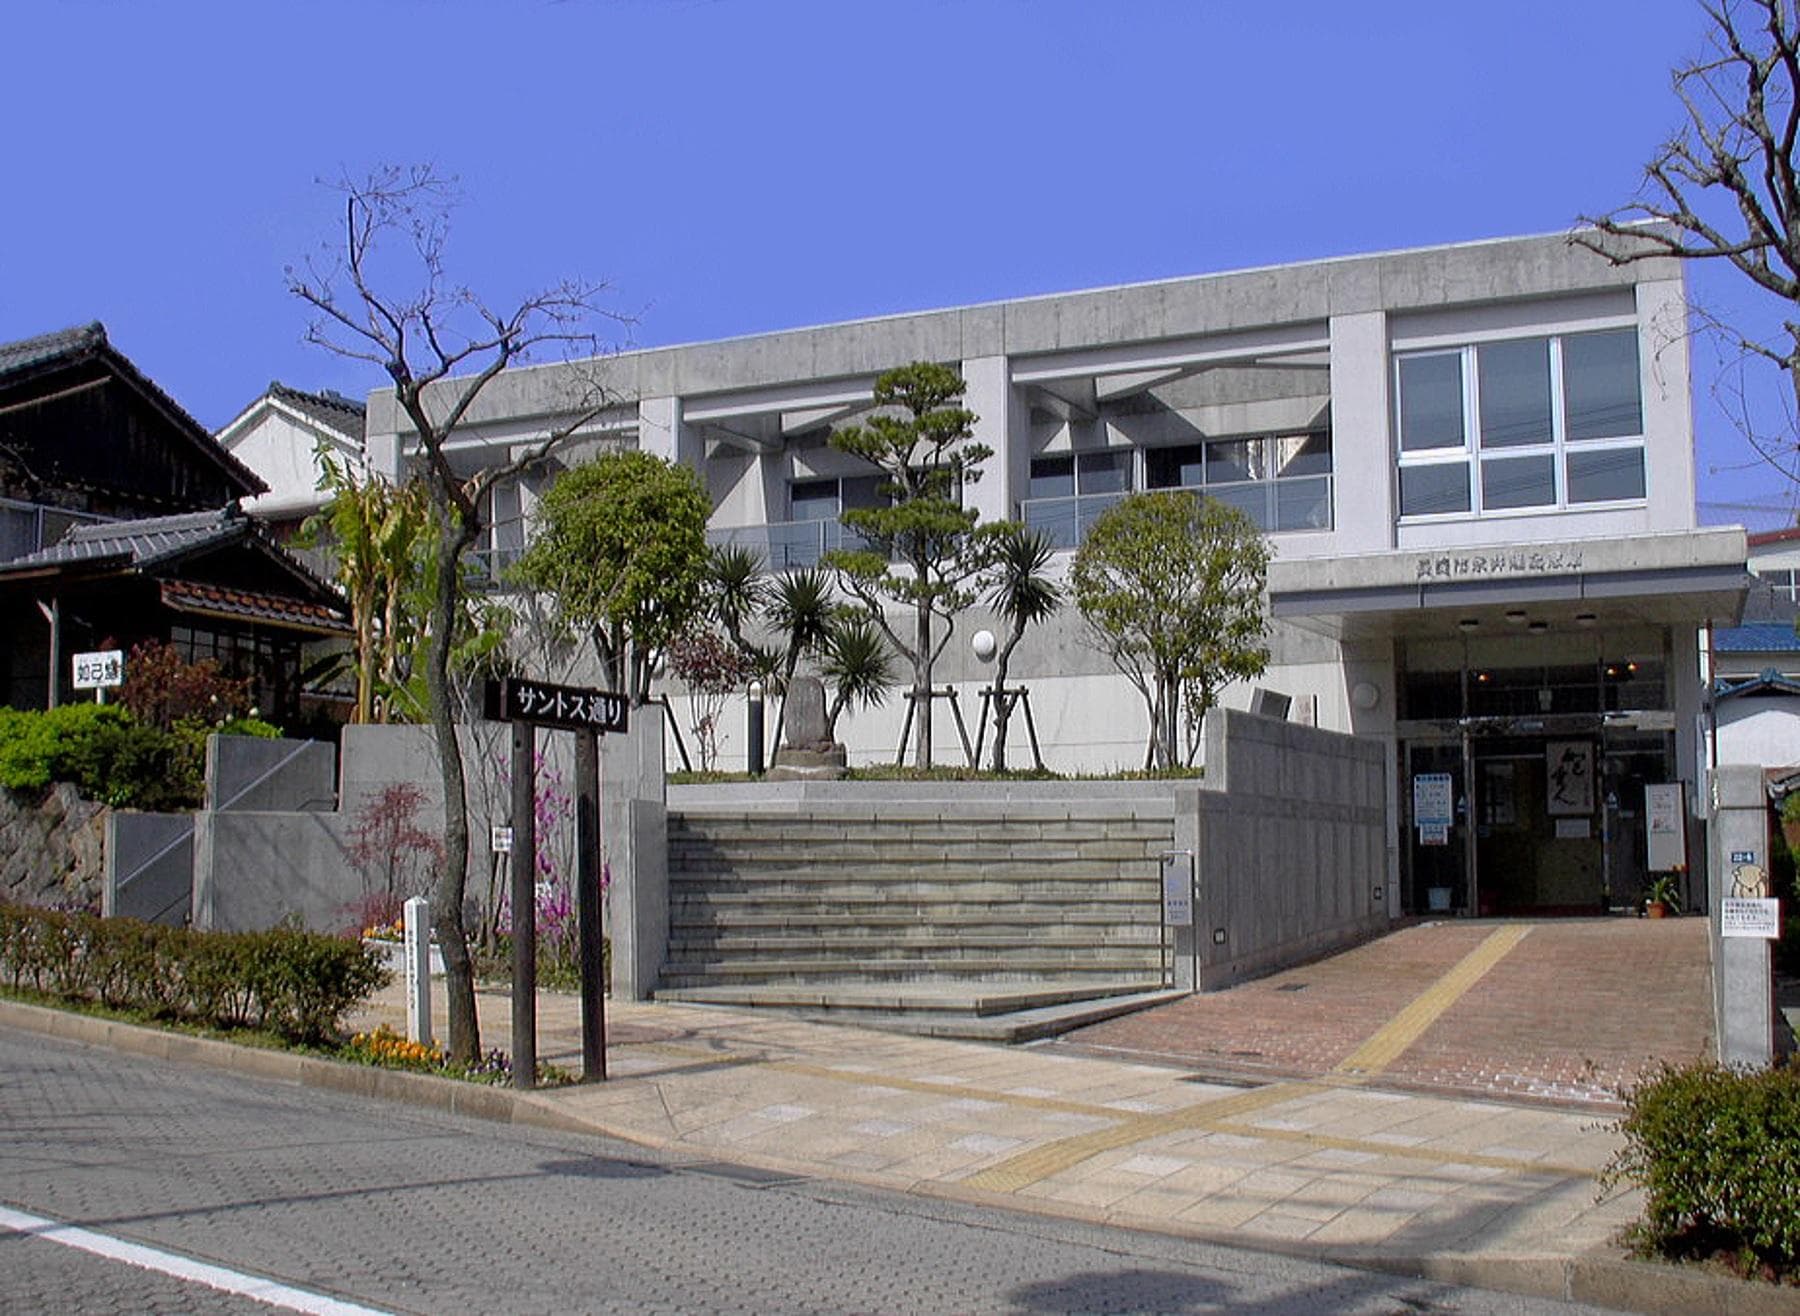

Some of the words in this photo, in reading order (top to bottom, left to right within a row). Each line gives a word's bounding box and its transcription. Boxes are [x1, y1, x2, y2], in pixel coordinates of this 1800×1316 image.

[517, 685, 622, 726] サントス通り
